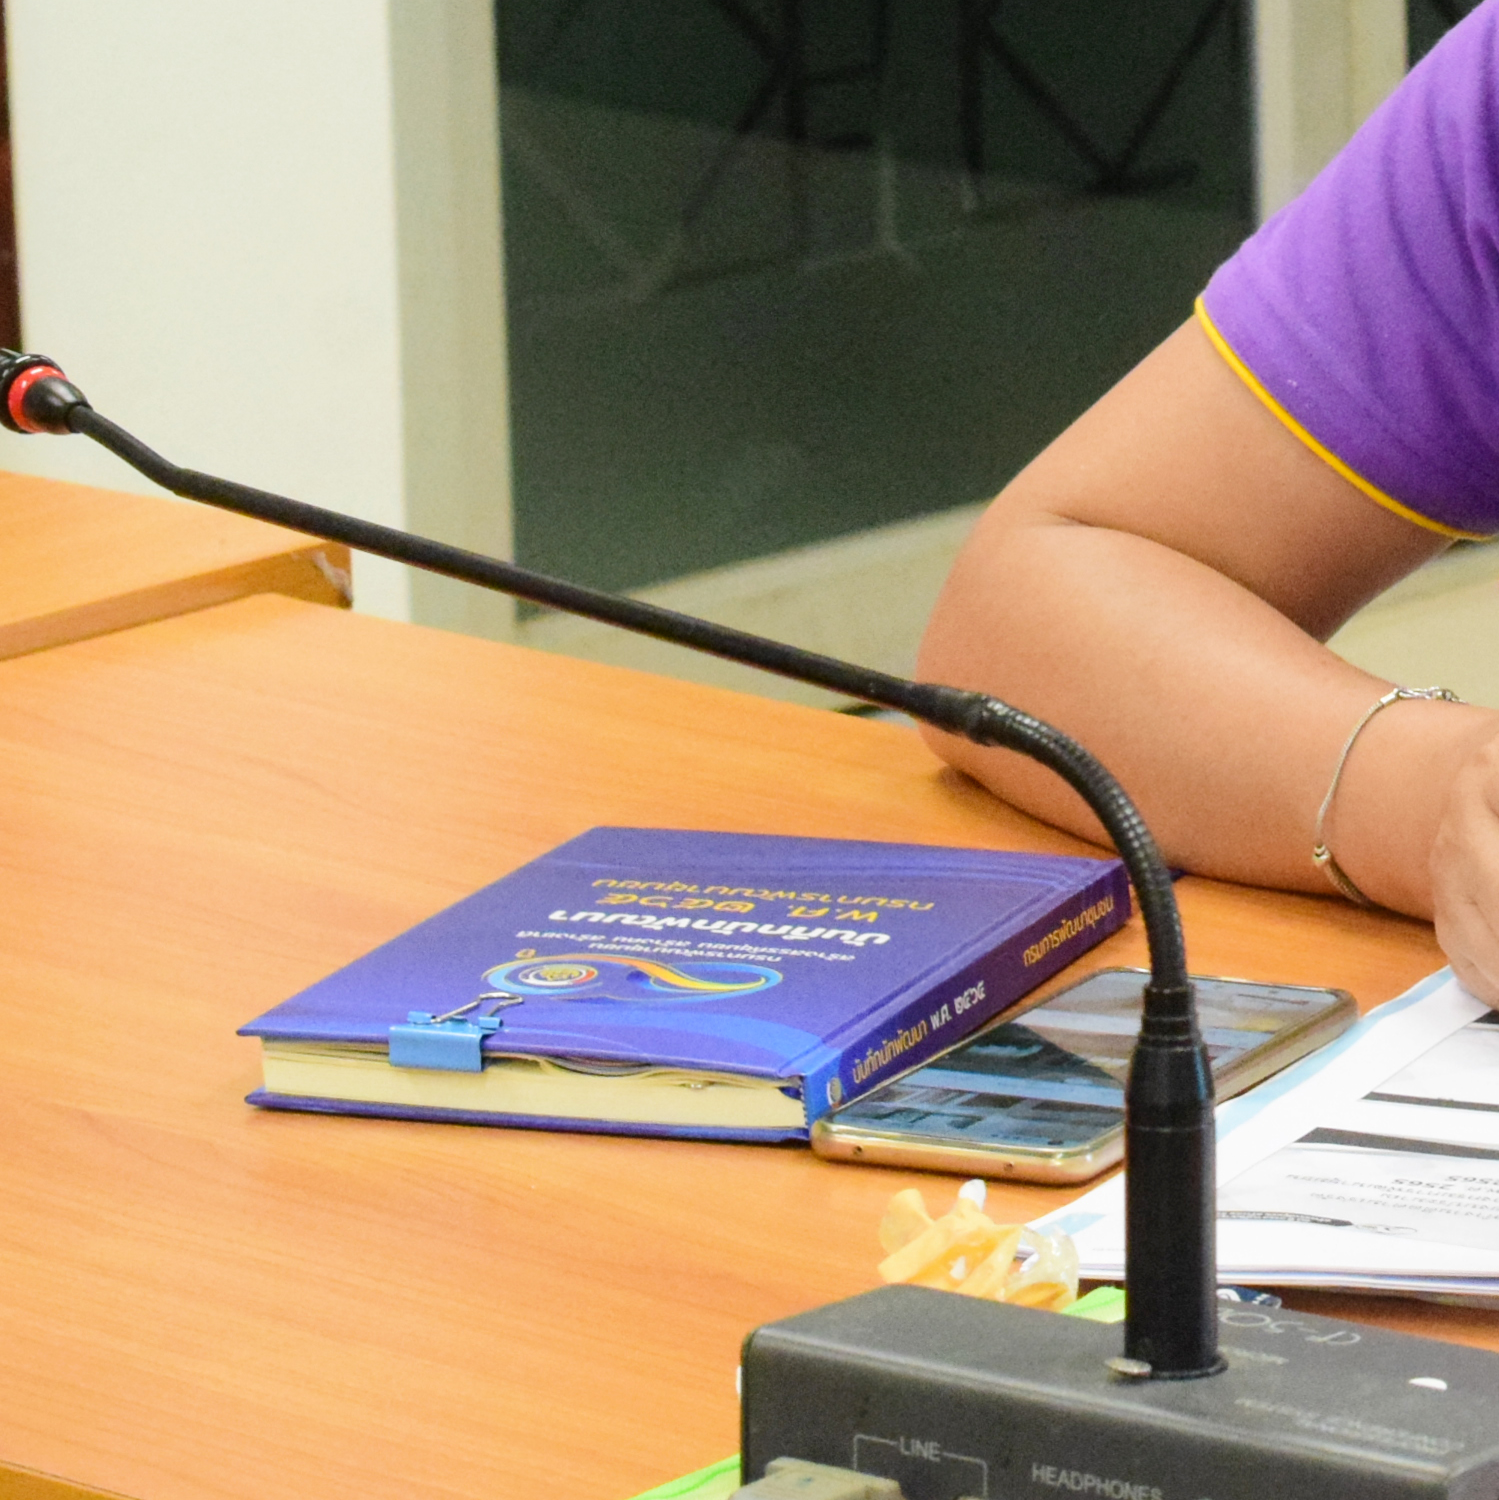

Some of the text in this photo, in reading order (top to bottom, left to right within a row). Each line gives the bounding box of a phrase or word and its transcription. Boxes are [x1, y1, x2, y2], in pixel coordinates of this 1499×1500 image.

[592, 879, 935, 911] กรมการพัฒนาชุมชน
[595, 893, 879, 923] พ.ศ. ๒๕๖๕
[548, 910, 891, 947] บันทึกนักพัฒนา
[1022, 895, 1115, 967] กรมการพัฒนาชุมชน
[588, 942, 782, 963] กรมการพัฒนาชุมชน
[852, 1018, 928, 1084] บันทึกนักพัฒนา
[929, 1002, 953, 1032] พ.ศ.
[1392, 1177, 1453, 1191] 2565
[900, 1436, 942, 1463] LINE
[1032, 1462, 1164, 1500] HEADPHONES
